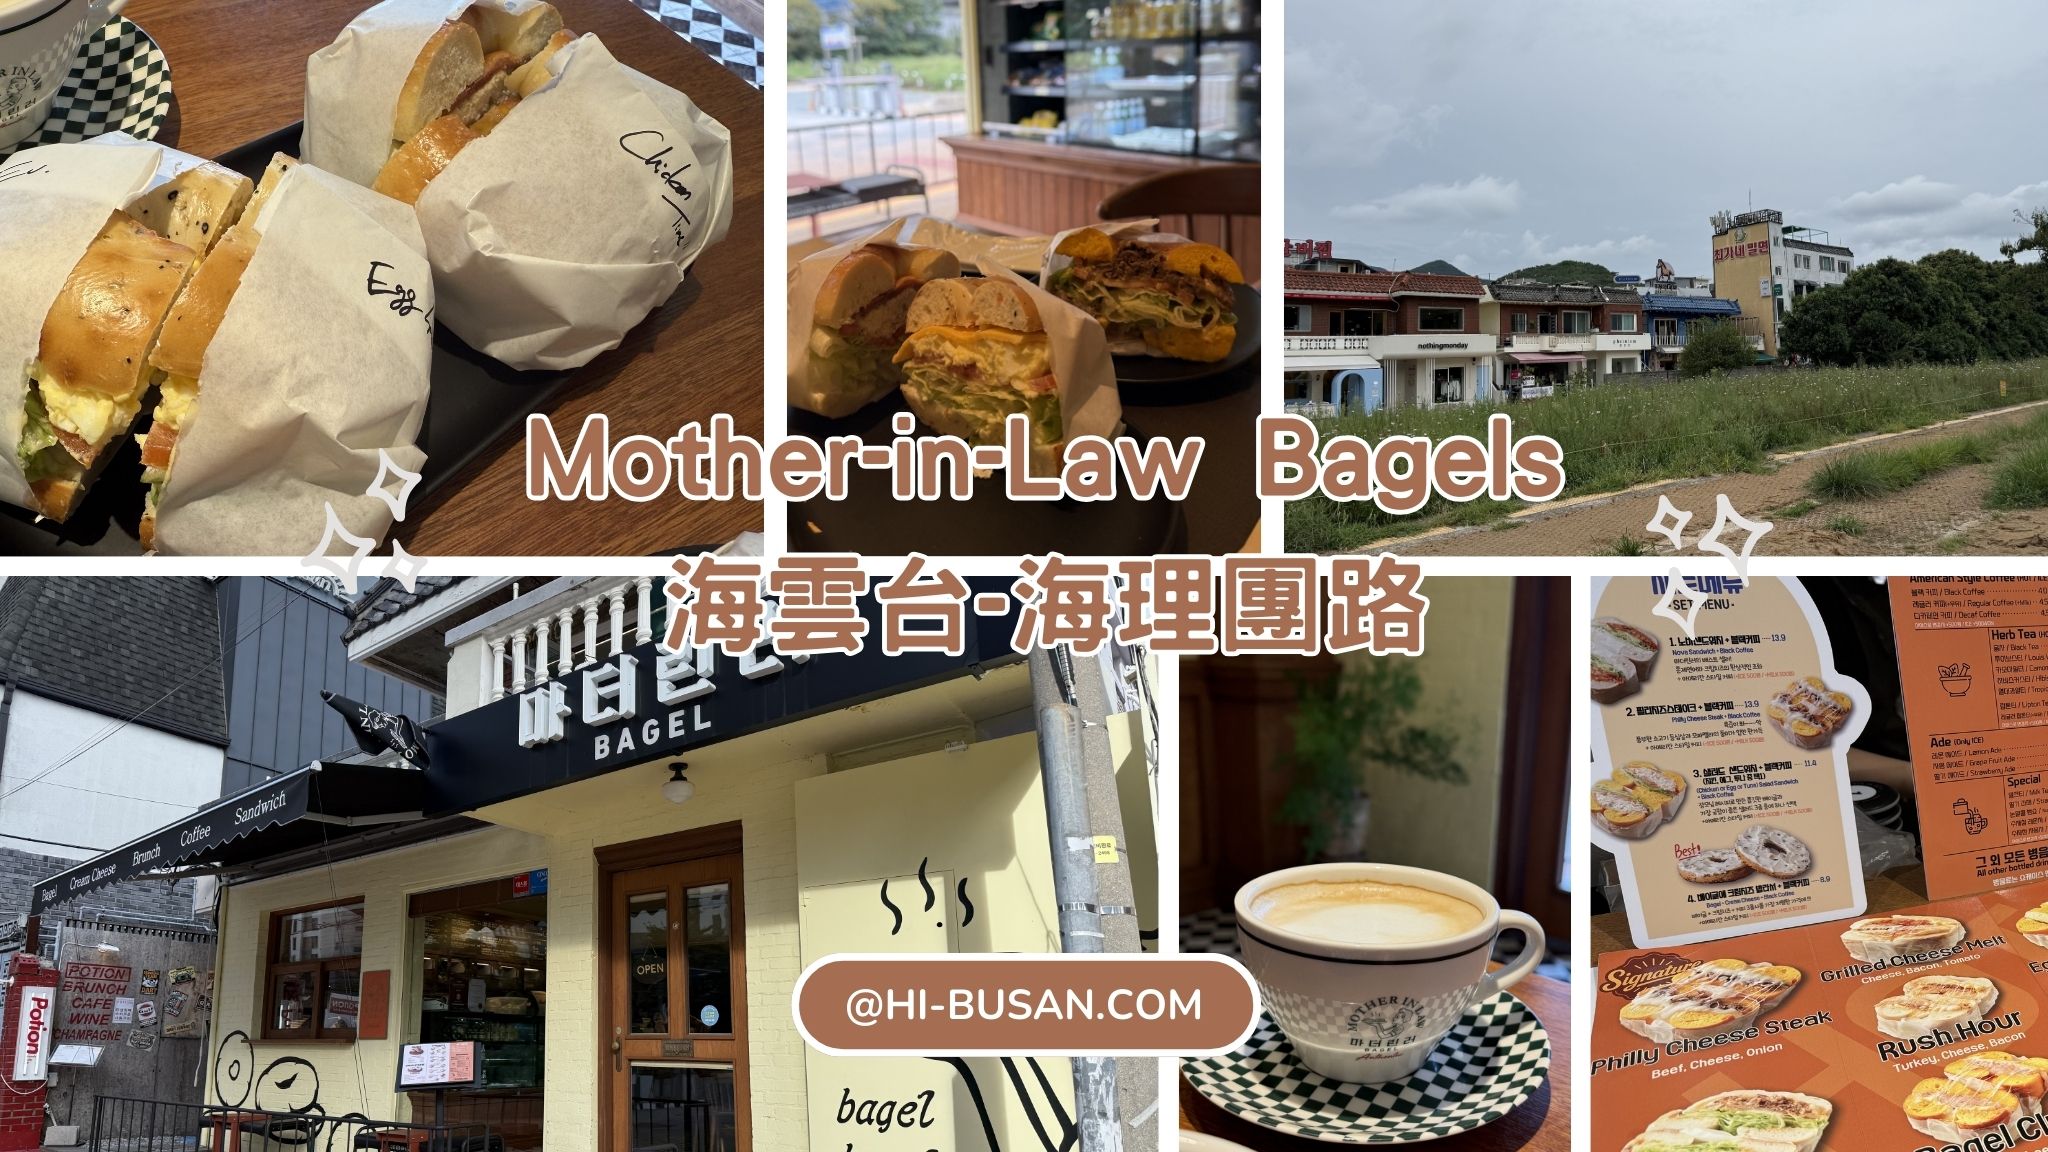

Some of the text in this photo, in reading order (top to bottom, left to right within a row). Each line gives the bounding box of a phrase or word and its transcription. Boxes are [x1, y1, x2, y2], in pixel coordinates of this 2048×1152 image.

[368, 261, 423, 317] Egg
[1418, 342, 1468, 350] nothingmonday
[1957, 576, 1980, 584] Style
[1944, 588, 1962, 596] Black
[1963, 588, 1985, 596] Coffee
[1968, 600, 1991, 608] Regular
[1730, 634, 1760, 645] 블랙커피
[1771, 634, 1786, 642] 13.9
[1992, 630, 2015, 640] Herb
[2018, 629, 2036, 638] Tea
[1626, 707, 1635, 717] 2.
[1704, 701, 1734, 712] 블랙커피
[1744, 700, 1760, 708] 13.9
[594, 704, 712, 760] BAGEL
[1930, 738, 1951, 748] Ade
[1954, 738, 1970, 746] (Only
[1693, 769, 1702, 778] 3.
[1970, 769, 2004, 777] Strawberry
[2008, 774, 2041, 788] Special
[42, 790, 286, 902] Bagel Cream Cheese Brunch Coffee Sandwich
[1674, 842, 1701, 858] Best!
[1976, 856, 1987, 869] 그
[1990, 854, 2001, 866] 외
[2004, 850, 2025, 864] 모든
[1977, 869, 1986, 877] All
[1988, 866, 2007, 875] other
[2009, 861, 2034, 873] bottled
[1820, 935, 2007, 983] Grilled Cheese Melt
[68, 965, 126, 980] POTION
[637, 963, 664, 975] OPEN
[1603, 960, 1703, 992] Signature
[1861, 953, 1981, 985] Cheese, Bacon, Tomato
[62, 981, 128, 995] BRUNCH
[72, 996, 113, 1010] CAFE
[69, 1013, 110, 1026] WINE
[1348, 996, 1426, 1032] MOTHER IN LAW
[26, 996, 48, 1057] Potion
[53, 1028, 122, 1041] CHAMPAGNE
[1590, 1010, 1833, 1076] Philly Cheese Steak
[1876, 1011, 2023, 1062] Rush Hour
[1892, 1031, 2026, 1073] Turkey, Cheese, Bacon
[1651, 1042, 1783, 1080] Beef, Cheese, Onion
[836, 1088, 935, 1133] bagel
